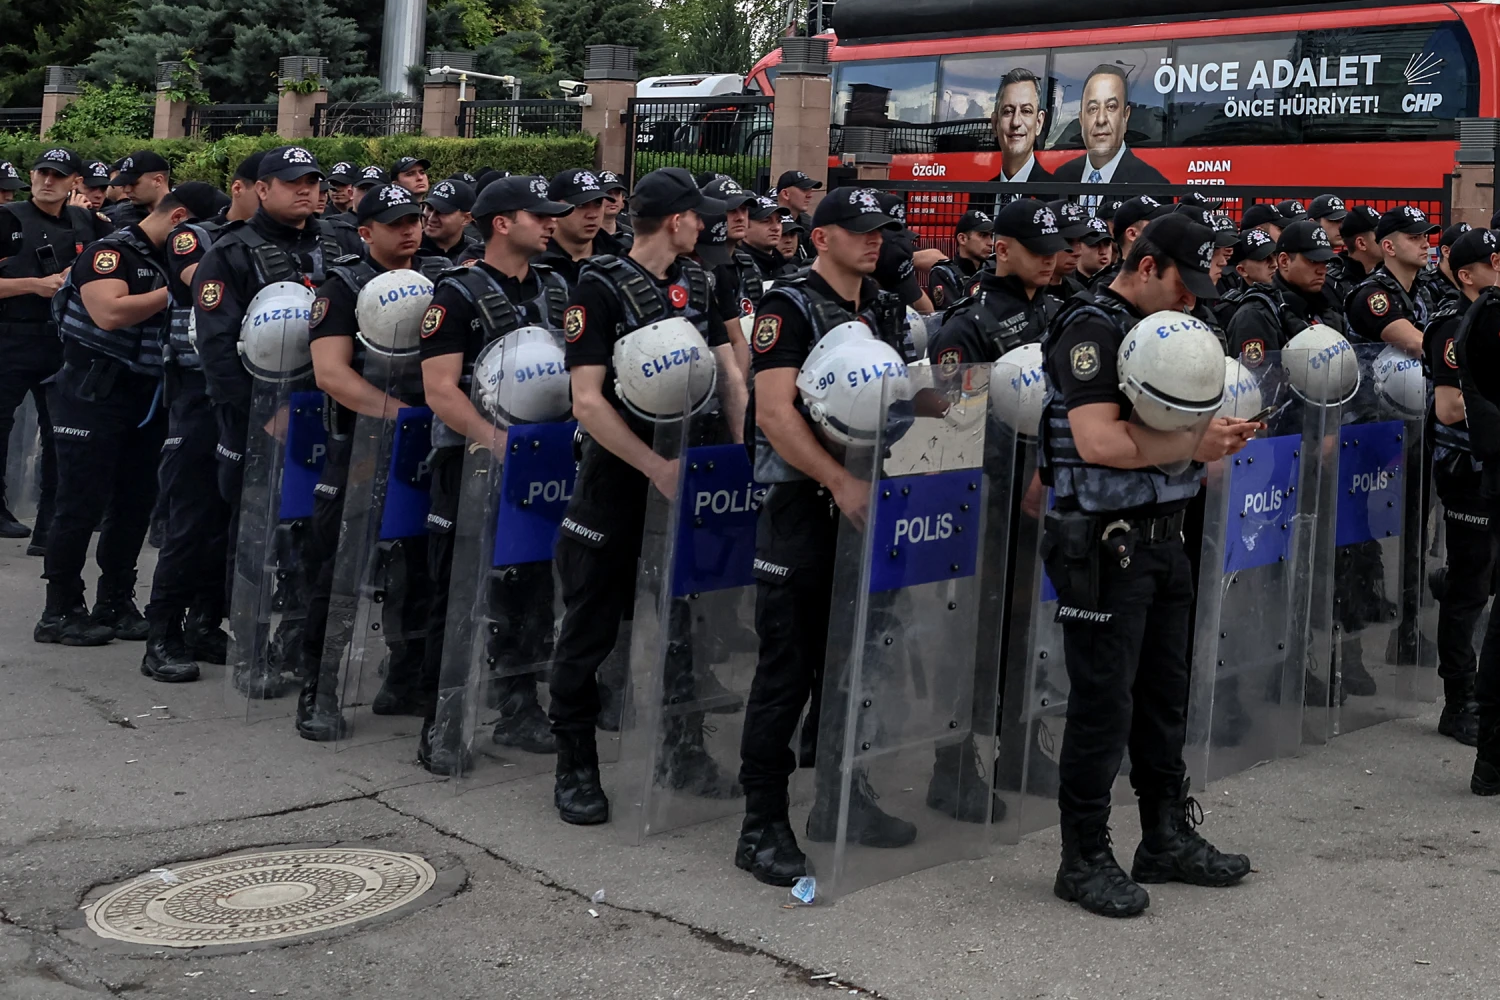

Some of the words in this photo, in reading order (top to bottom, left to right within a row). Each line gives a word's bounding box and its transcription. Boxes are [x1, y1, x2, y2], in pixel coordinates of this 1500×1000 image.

[1153, 57, 1239, 94] ÖNCE
[1247, 54, 1382, 90] ADALET
[1223, 96, 1274, 118] ÖNCE
[1279, 93, 1379, 116] HÜRRİYET!
[1402, 92, 1443, 113] CHP
[288, 156, 312, 165] POLİS
[912, 163, 946, 177] ÖZGÜR
[1187, 159, 1231, 173] ADNAN
[387, 196, 412, 208] POLİS
[514, 360, 569, 383] 12116
[1353, 466, 1388, 494] POLİS
[694, 481, 767, 516] POLİS
[1244, 484, 1282, 516] POLİS
[894, 512, 953, 546] POLİS
[1464, 513, 1489, 526] KUVVET
[577, 526, 604, 543] KUVVET
[763, 562, 788, 577] KUVVET
[1059, 605, 1078, 617] ÇEVİK
[1077, 608, 1113, 623] KUVVET
